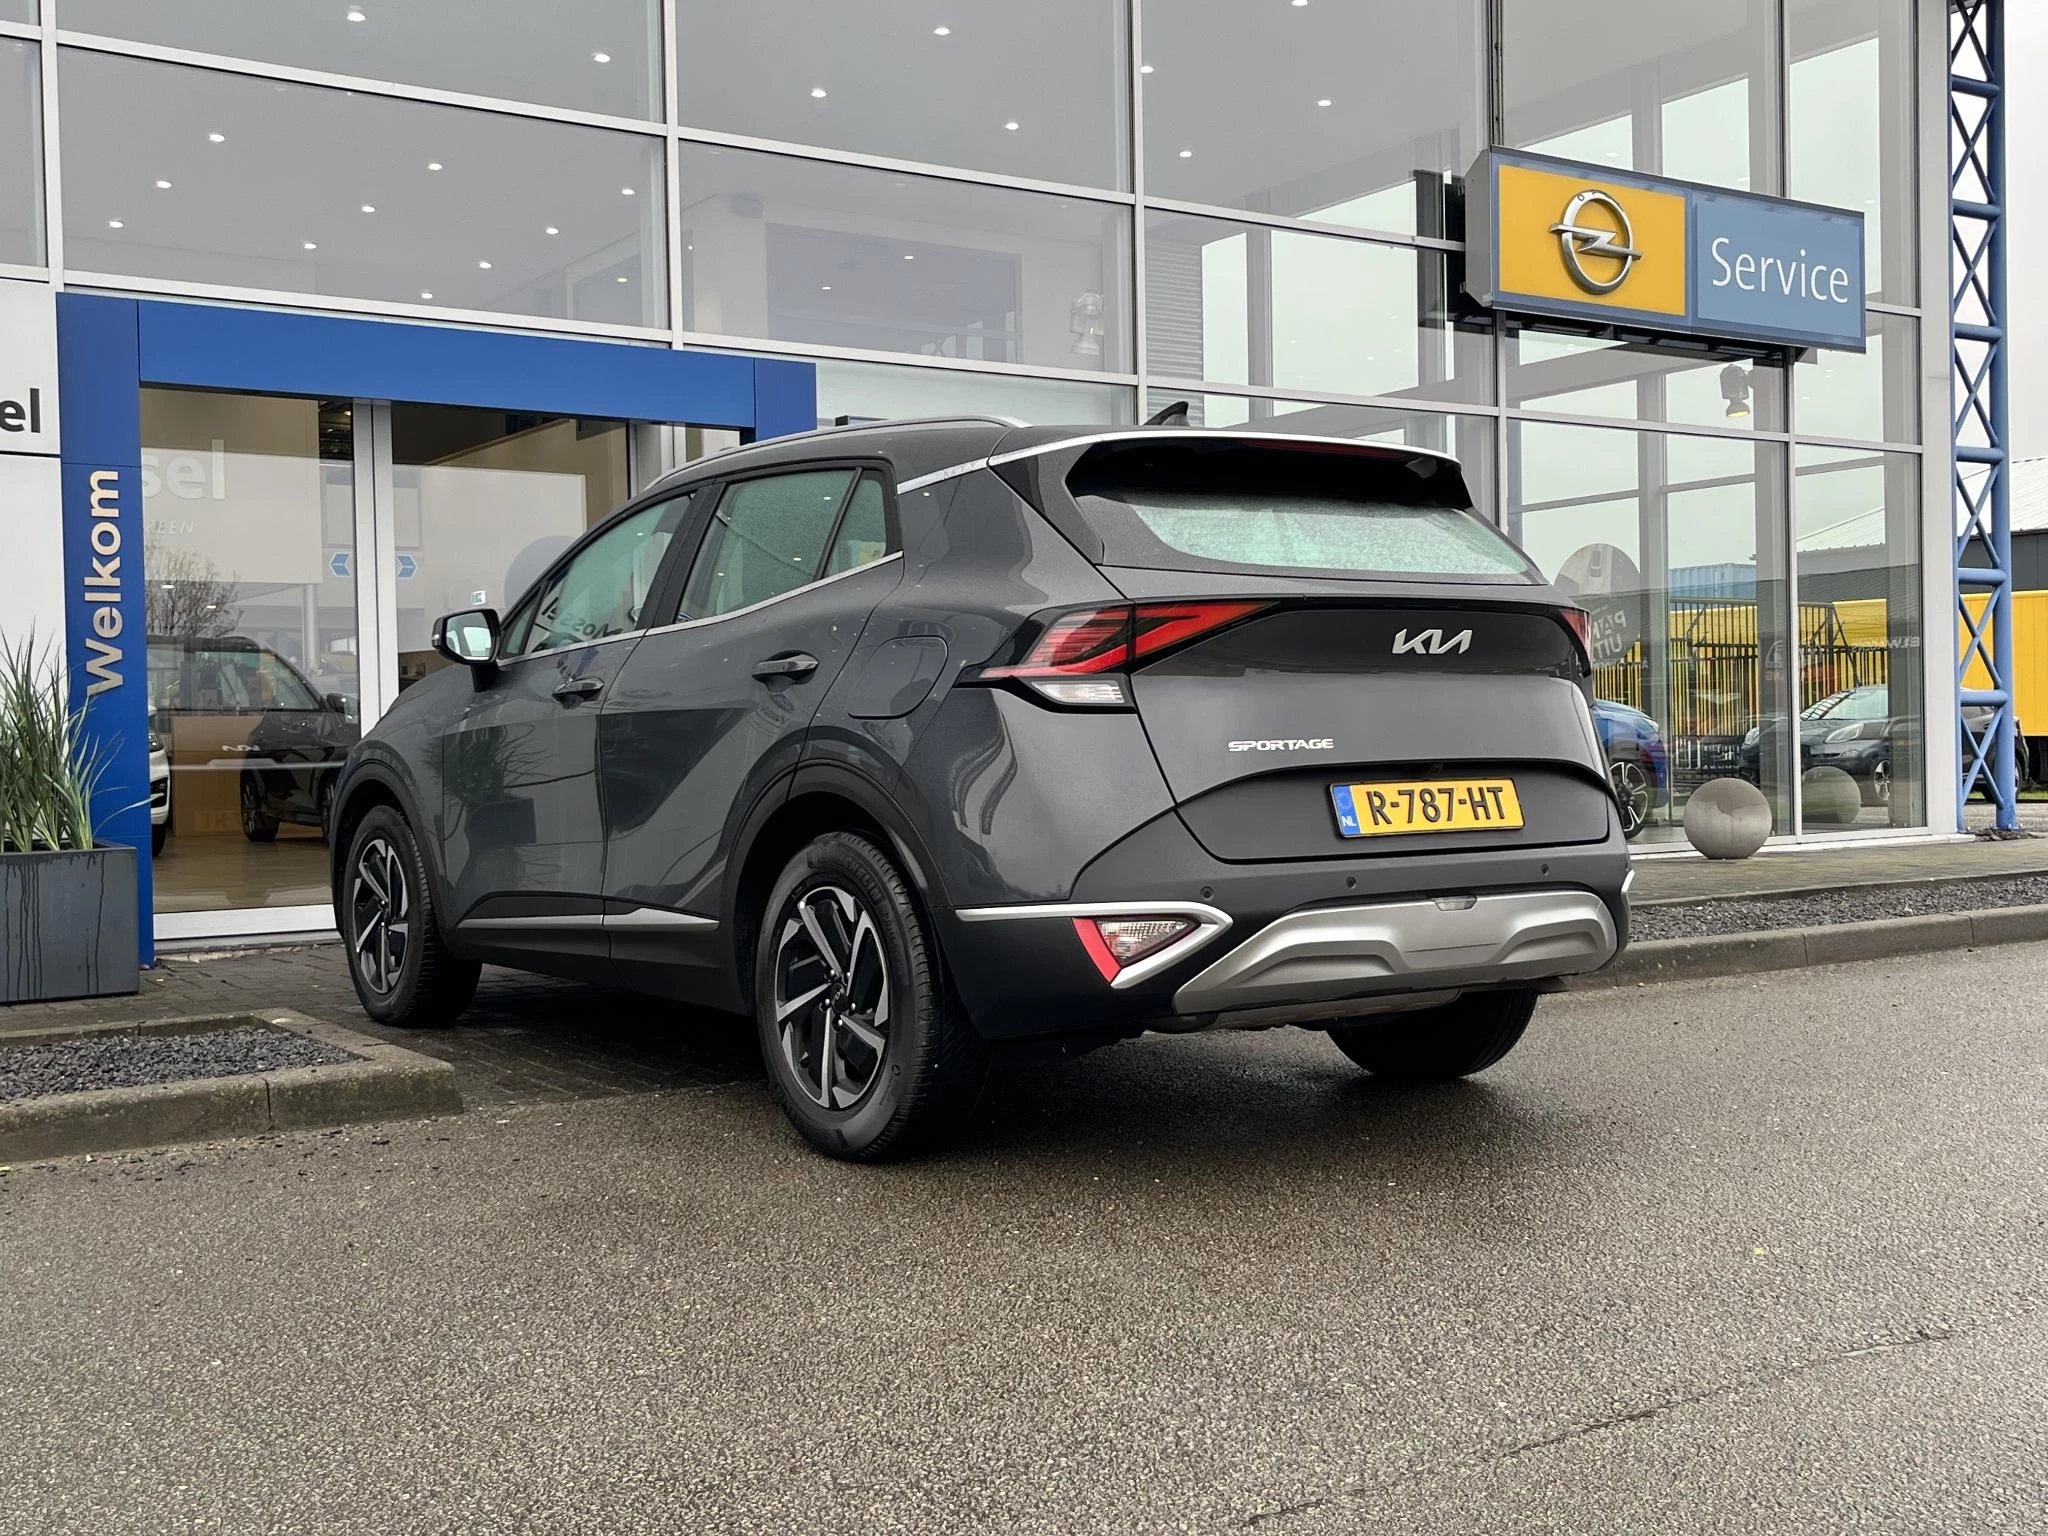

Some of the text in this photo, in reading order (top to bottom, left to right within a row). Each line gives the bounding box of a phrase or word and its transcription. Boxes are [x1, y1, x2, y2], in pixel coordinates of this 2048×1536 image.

[1710, 237, 1849, 303] Service
[83, 470, 124, 696] Welkom
[1392, 628, 1473, 655] KIA
[1228, 738, 1335, 752] SPORTAGE
[1341, 815, 1357, 827] NL
[1366, 786, 1507, 826] R-787-HT
